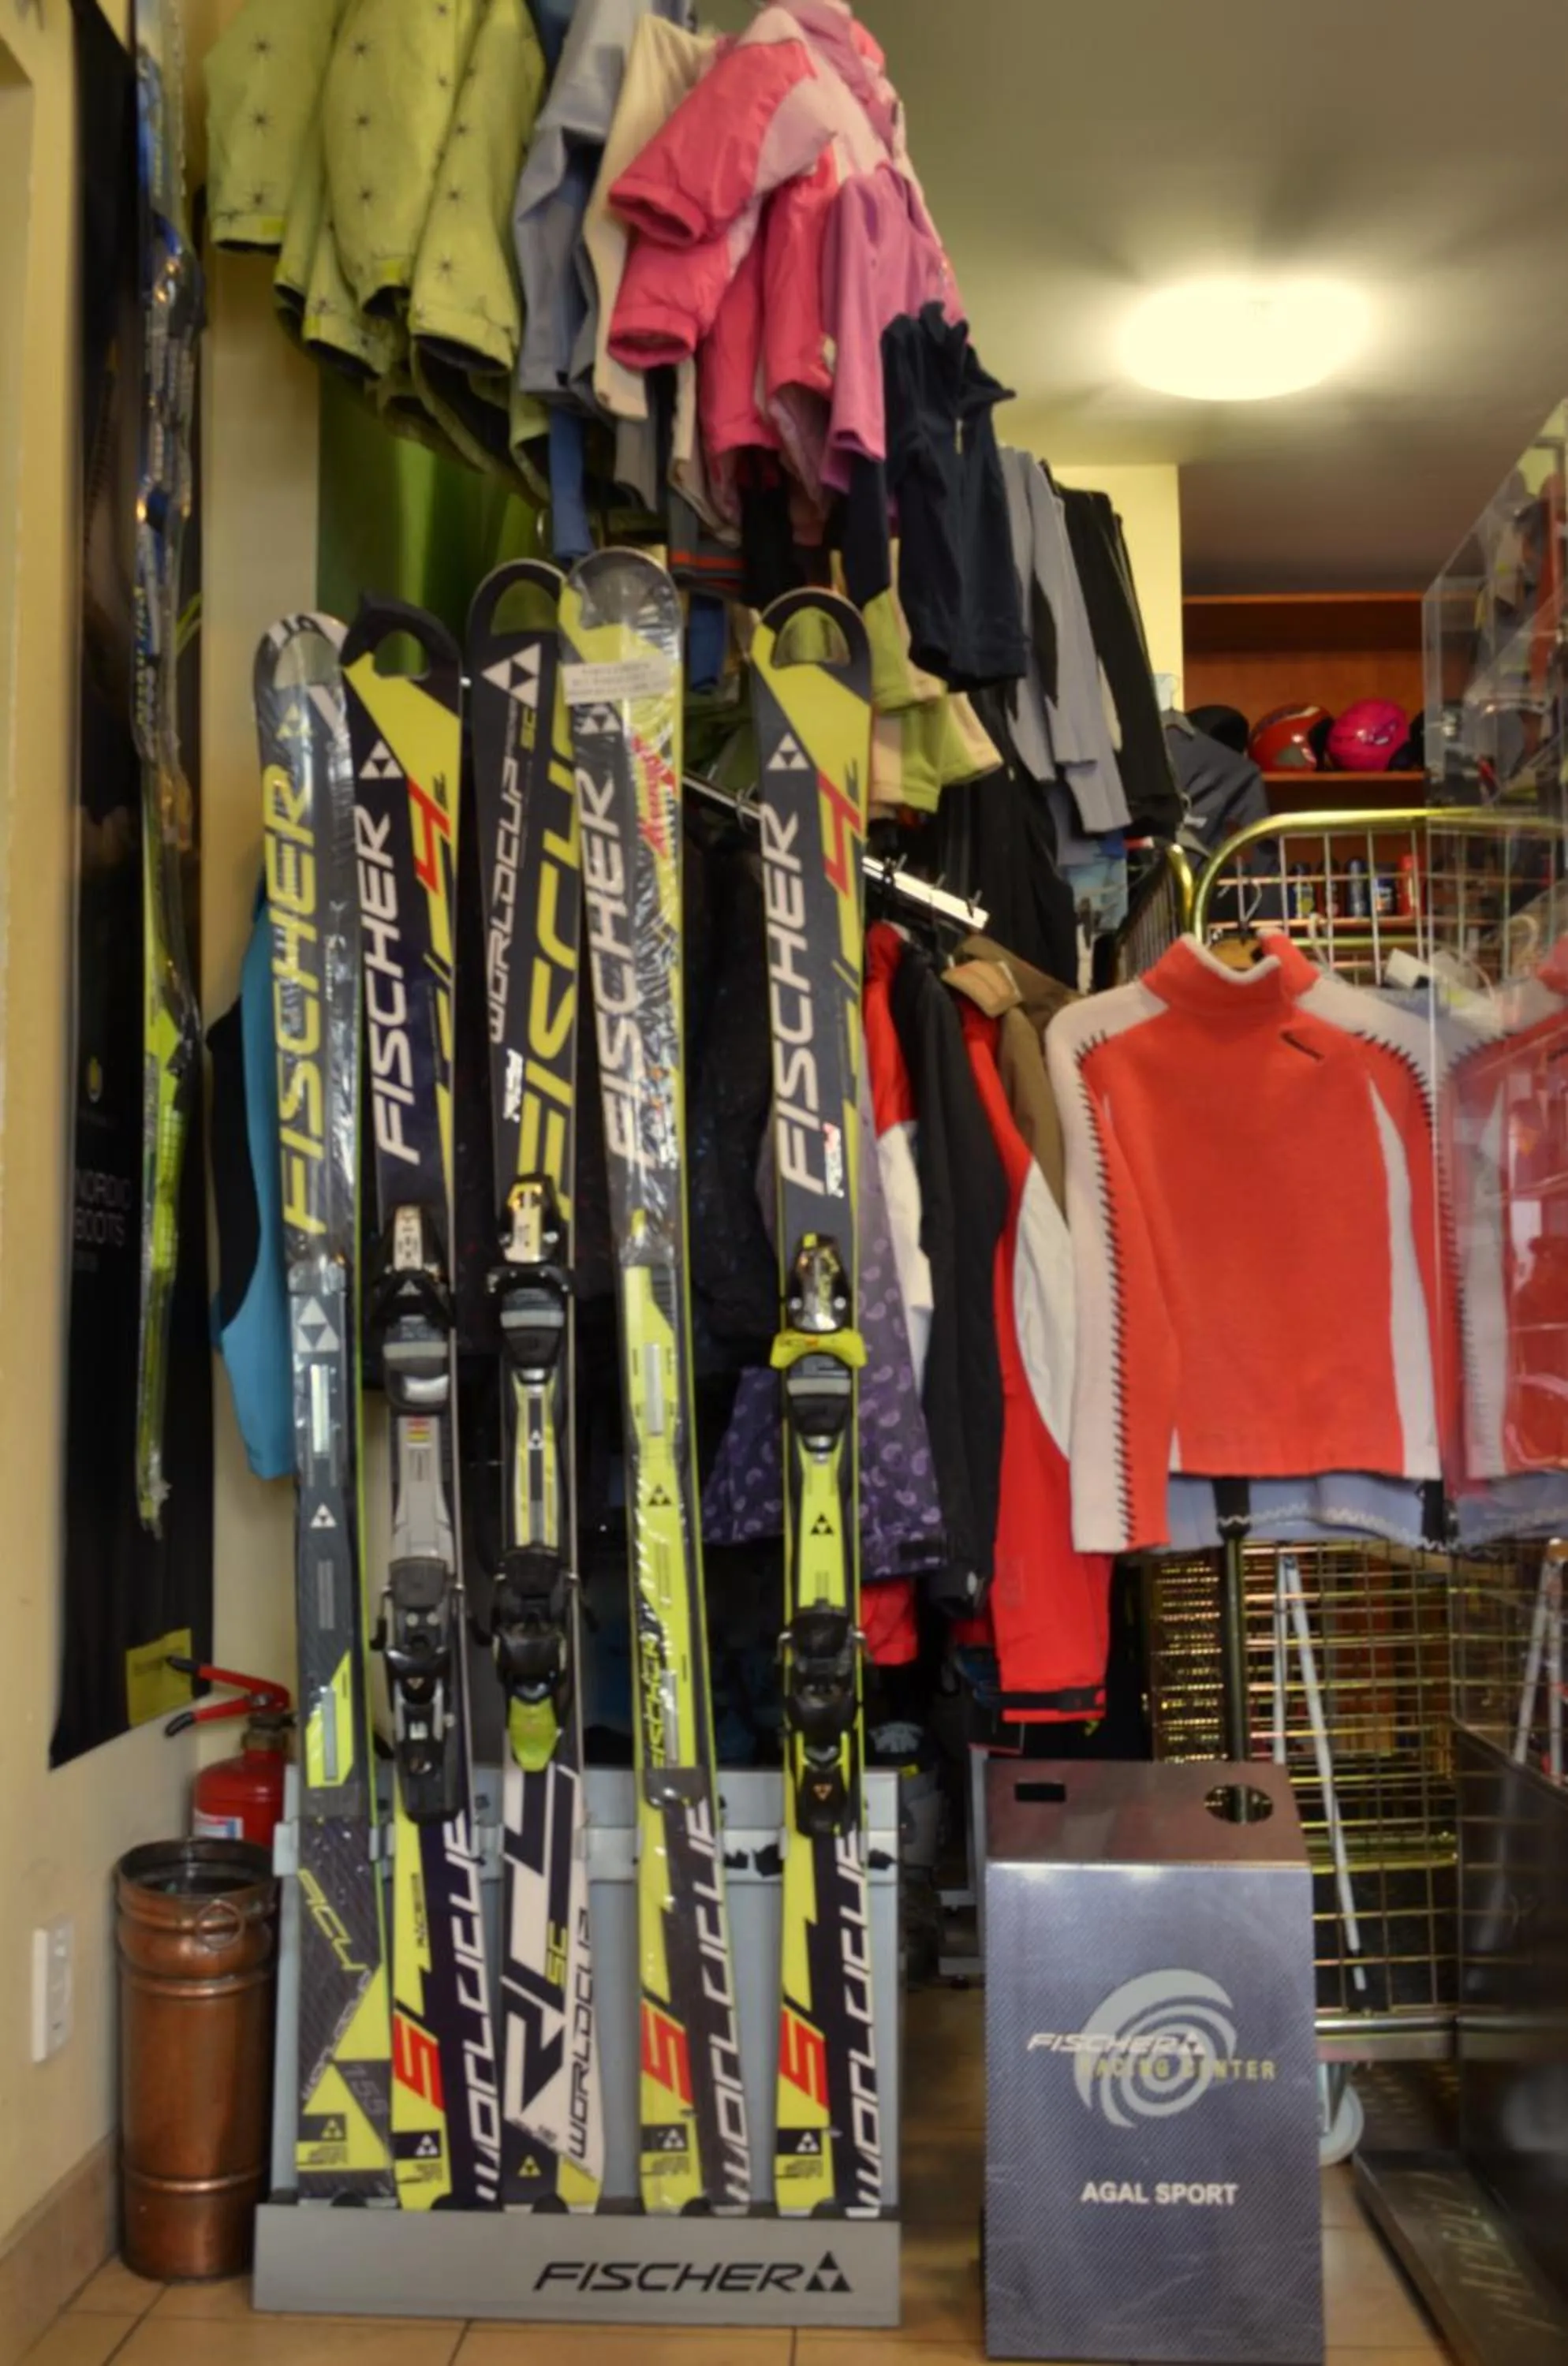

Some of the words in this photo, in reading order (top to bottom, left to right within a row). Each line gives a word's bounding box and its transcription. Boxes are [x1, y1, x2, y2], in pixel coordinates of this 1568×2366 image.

[262, 764, 327, 1235] FISCHER
[354, 804, 421, 1166] FISCHER
[488, 756, 522, 1043] WORLDCUP
[575, 767, 655, 1170] FISCHER
[760, 801, 826, 1196] FISCHER
[546, 1919, 569, 1987] SC
[1028, 2032, 1178, 2054] FISCHER
[533, 2262, 805, 2292] FISCHER
[1081, 2181, 1149, 2204] AGAL
[1155, 2182, 1238, 2206] SPORT
